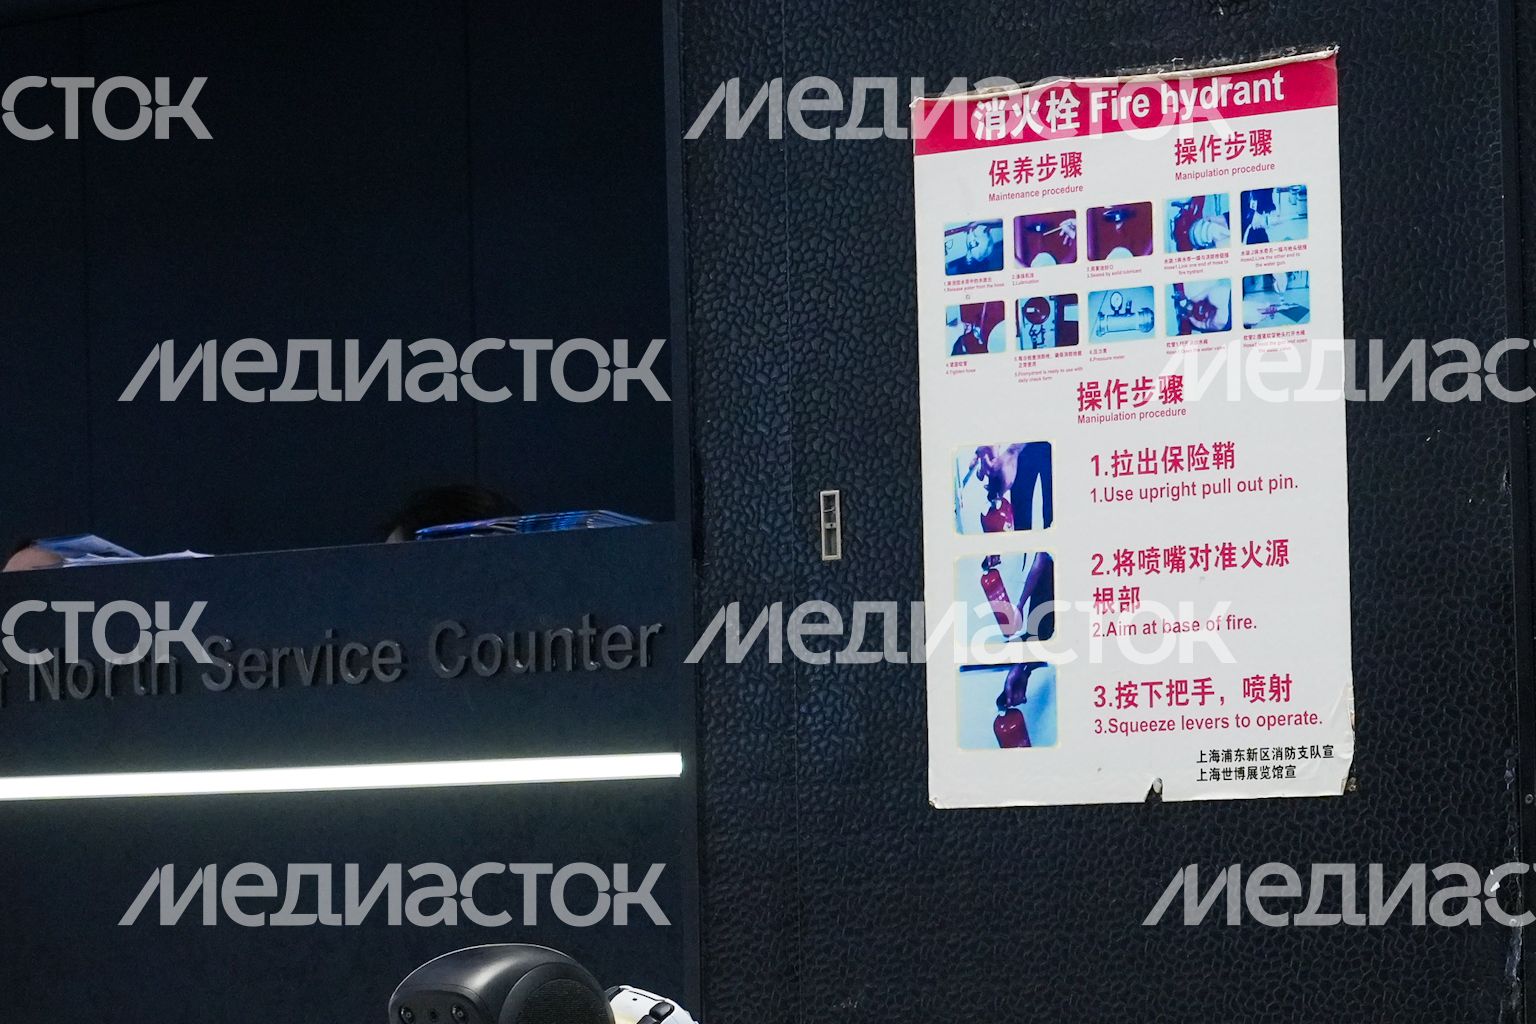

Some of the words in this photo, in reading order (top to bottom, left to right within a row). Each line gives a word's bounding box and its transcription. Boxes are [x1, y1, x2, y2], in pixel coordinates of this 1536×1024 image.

[973, 91, 1082, 141] 消火栓
[1090, 87, 1150, 124] Fire
[1161, 71, 1285, 123] hydrant
[1174, 128, 1273, 167] 操作步骤
[988, 151, 1083, 188] 保养步骤
[1174, 167, 1229, 181] Manipulation
[1231, 162, 1276, 178] procedure
[988, 187, 1039, 204] Maintenance
[1041, 184, 1084, 199] procedure
[1076, 375, 1185, 411] 操作步骤
[1077, 410, 1137, 425] Manipulation
[1139, 407, 1187, 422] procedure
[1090, 486, 1134, 504] 1.Use
[1139, 482, 1197, 507] upright
[1201, 478, 1232, 499] pull
[1236, 476, 1264, 493] out
[1268, 474, 1299, 497] pin.
[1091, 538, 1290, 577] 2.将喷嘴对准火源
[1093, 585, 1141, 616] 根部
[1092, 619, 1137, 639] 2.Aim
[1142, 619, 1159, 636] at
[1162, 617, 1201, 634] base
[1205, 614, 1222, 632] of
[1225, 613, 1258, 631] fire.
[28, 640, 180, 703] North
[200, 628, 405, 692] Service
[428, 612, 664, 680] Counter
[1094, 716, 1176, 737] 3.Squeeze
[1180, 713, 1230, 731] levers
[1235, 712, 1251, 729] to
[1256, 710, 1323, 732] operate.
[1196, 744, 1335, 765] 上海浦东新区消防支队宣
[1196, 764, 1297, 783] 上海世博展览馆宣
